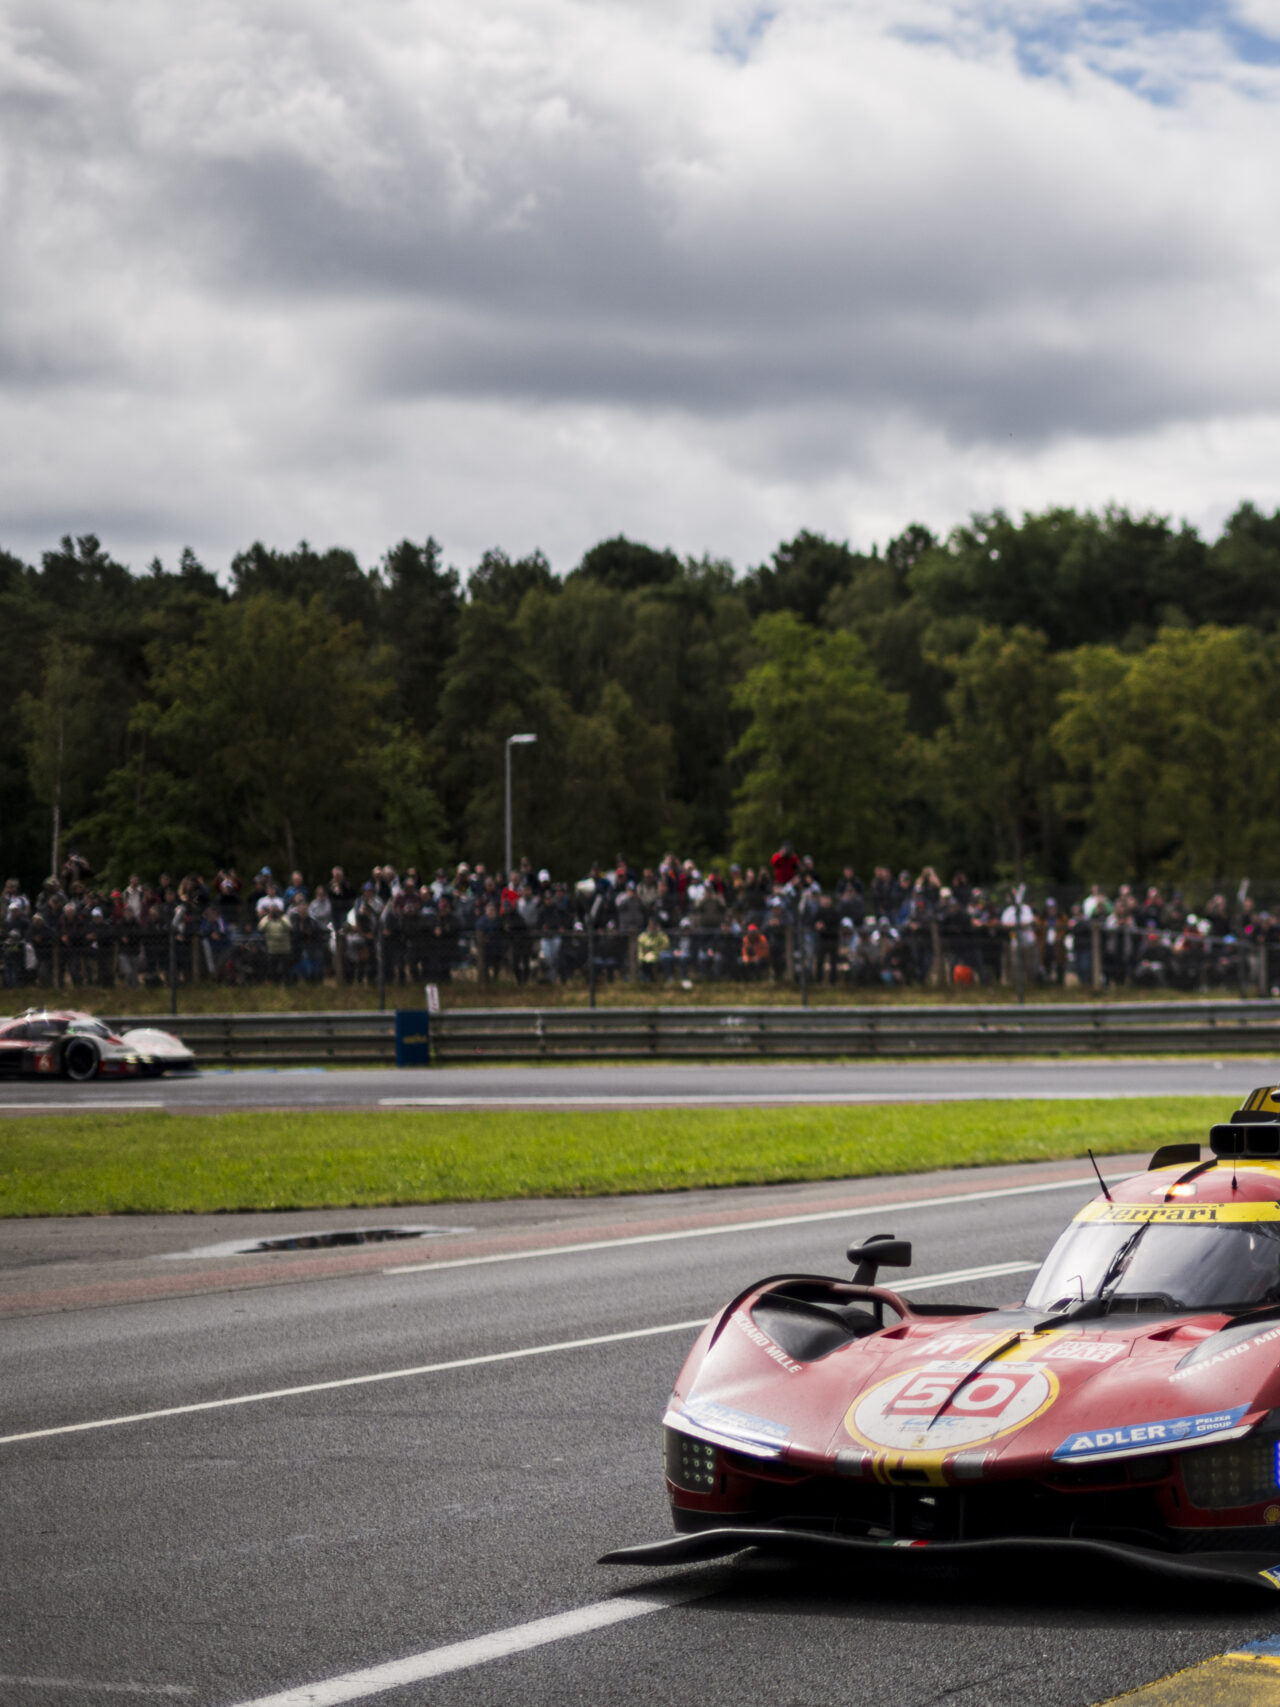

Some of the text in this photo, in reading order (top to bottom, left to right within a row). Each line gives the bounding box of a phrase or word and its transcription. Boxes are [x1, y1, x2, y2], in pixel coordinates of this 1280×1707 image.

[1098, 1203, 1225, 1221] Ferrari
[764, 1345, 803, 1373] MILLE
[893, 1377, 1016, 1411] 50
[1195, 1415, 1232, 1426] PELZER
[1196, 1421, 1232, 1432] GROUP
[1070, 1425, 1166, 1452] ADLER
